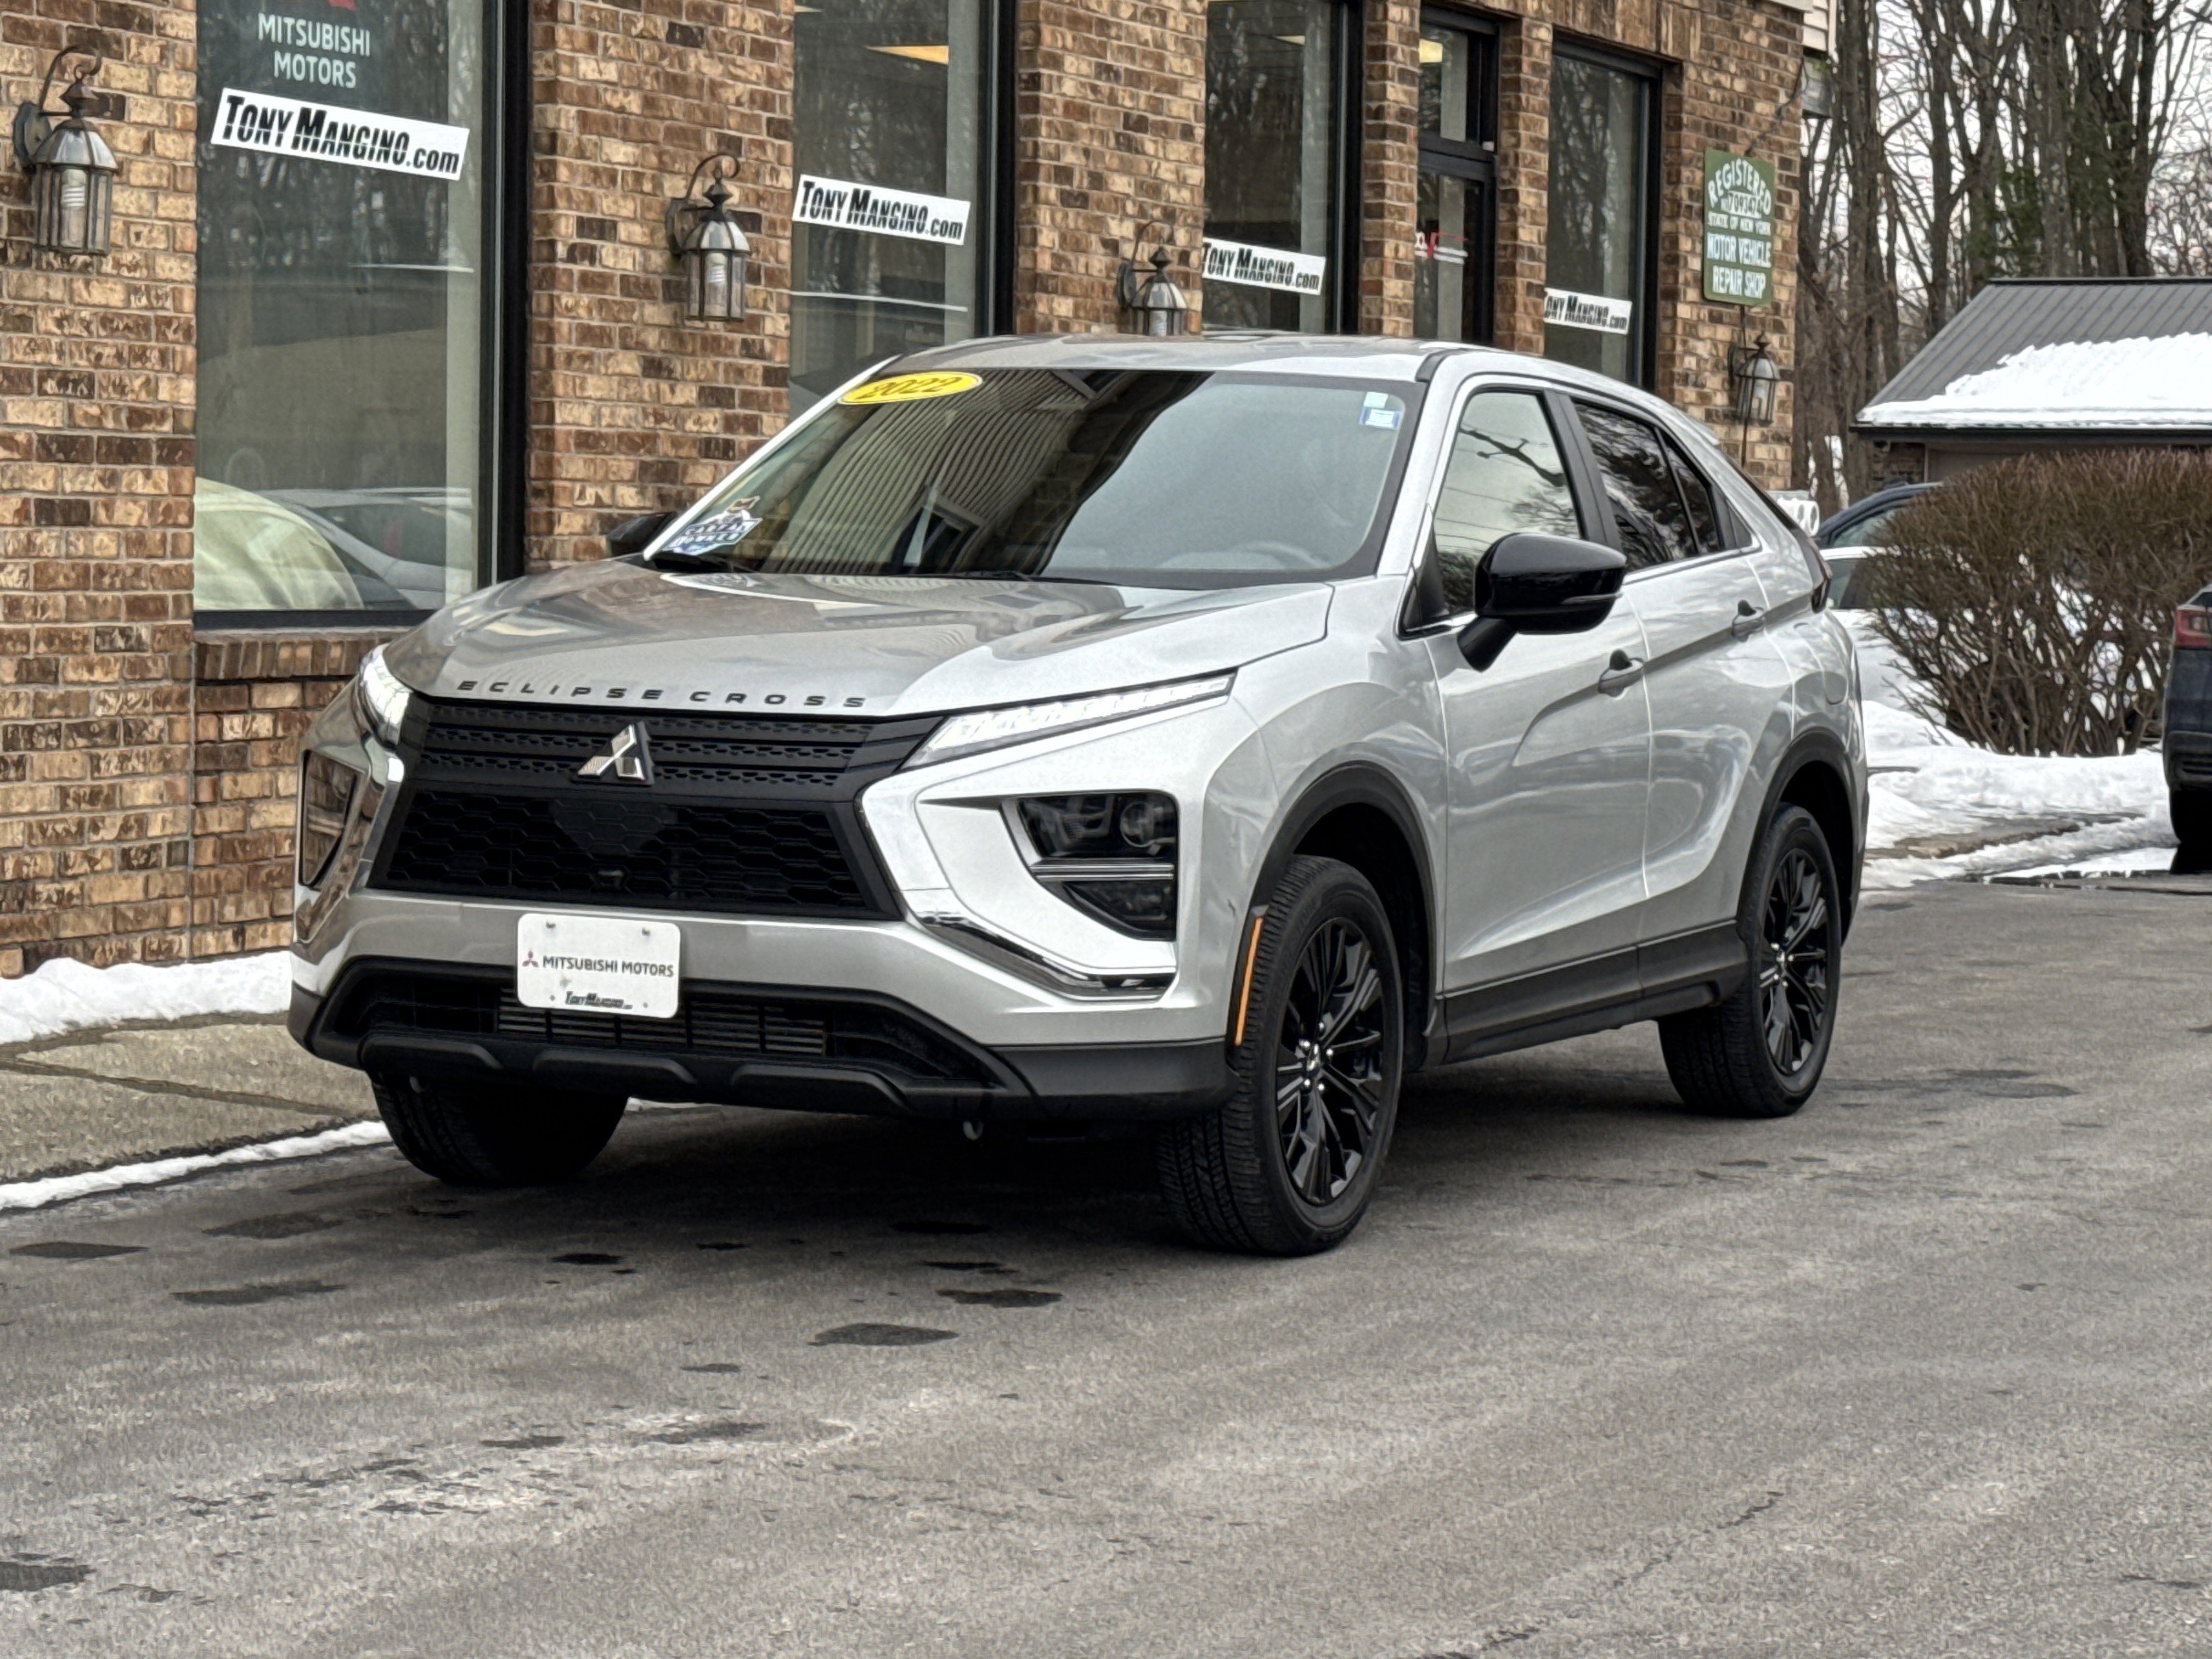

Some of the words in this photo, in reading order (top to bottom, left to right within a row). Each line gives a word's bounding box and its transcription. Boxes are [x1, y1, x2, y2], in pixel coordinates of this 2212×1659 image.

[258, 13, 370, 57] MITSUBISHI
[274, 50, 356, 88] MOTORS
[1708, 157, 1771, 215] REGISTERED
[1707, 232, 1737, 263] MOTOR
[1737, 237, 1772, 268] VEHICLE
[1712, 264, 1743, 296] REPAIR
[1744, 270, 1767, 300] SHOP
[1544, 295, 1566, 321] ONY
[854, 376, 963, 400] 2022
[456, 680, 664, 702] ECLIPSE
[688, 690, 866, 709] CROSS
[543, 955, 618, 973] MITSUBISHI
[622, 961, 674, 978] MOTORS
